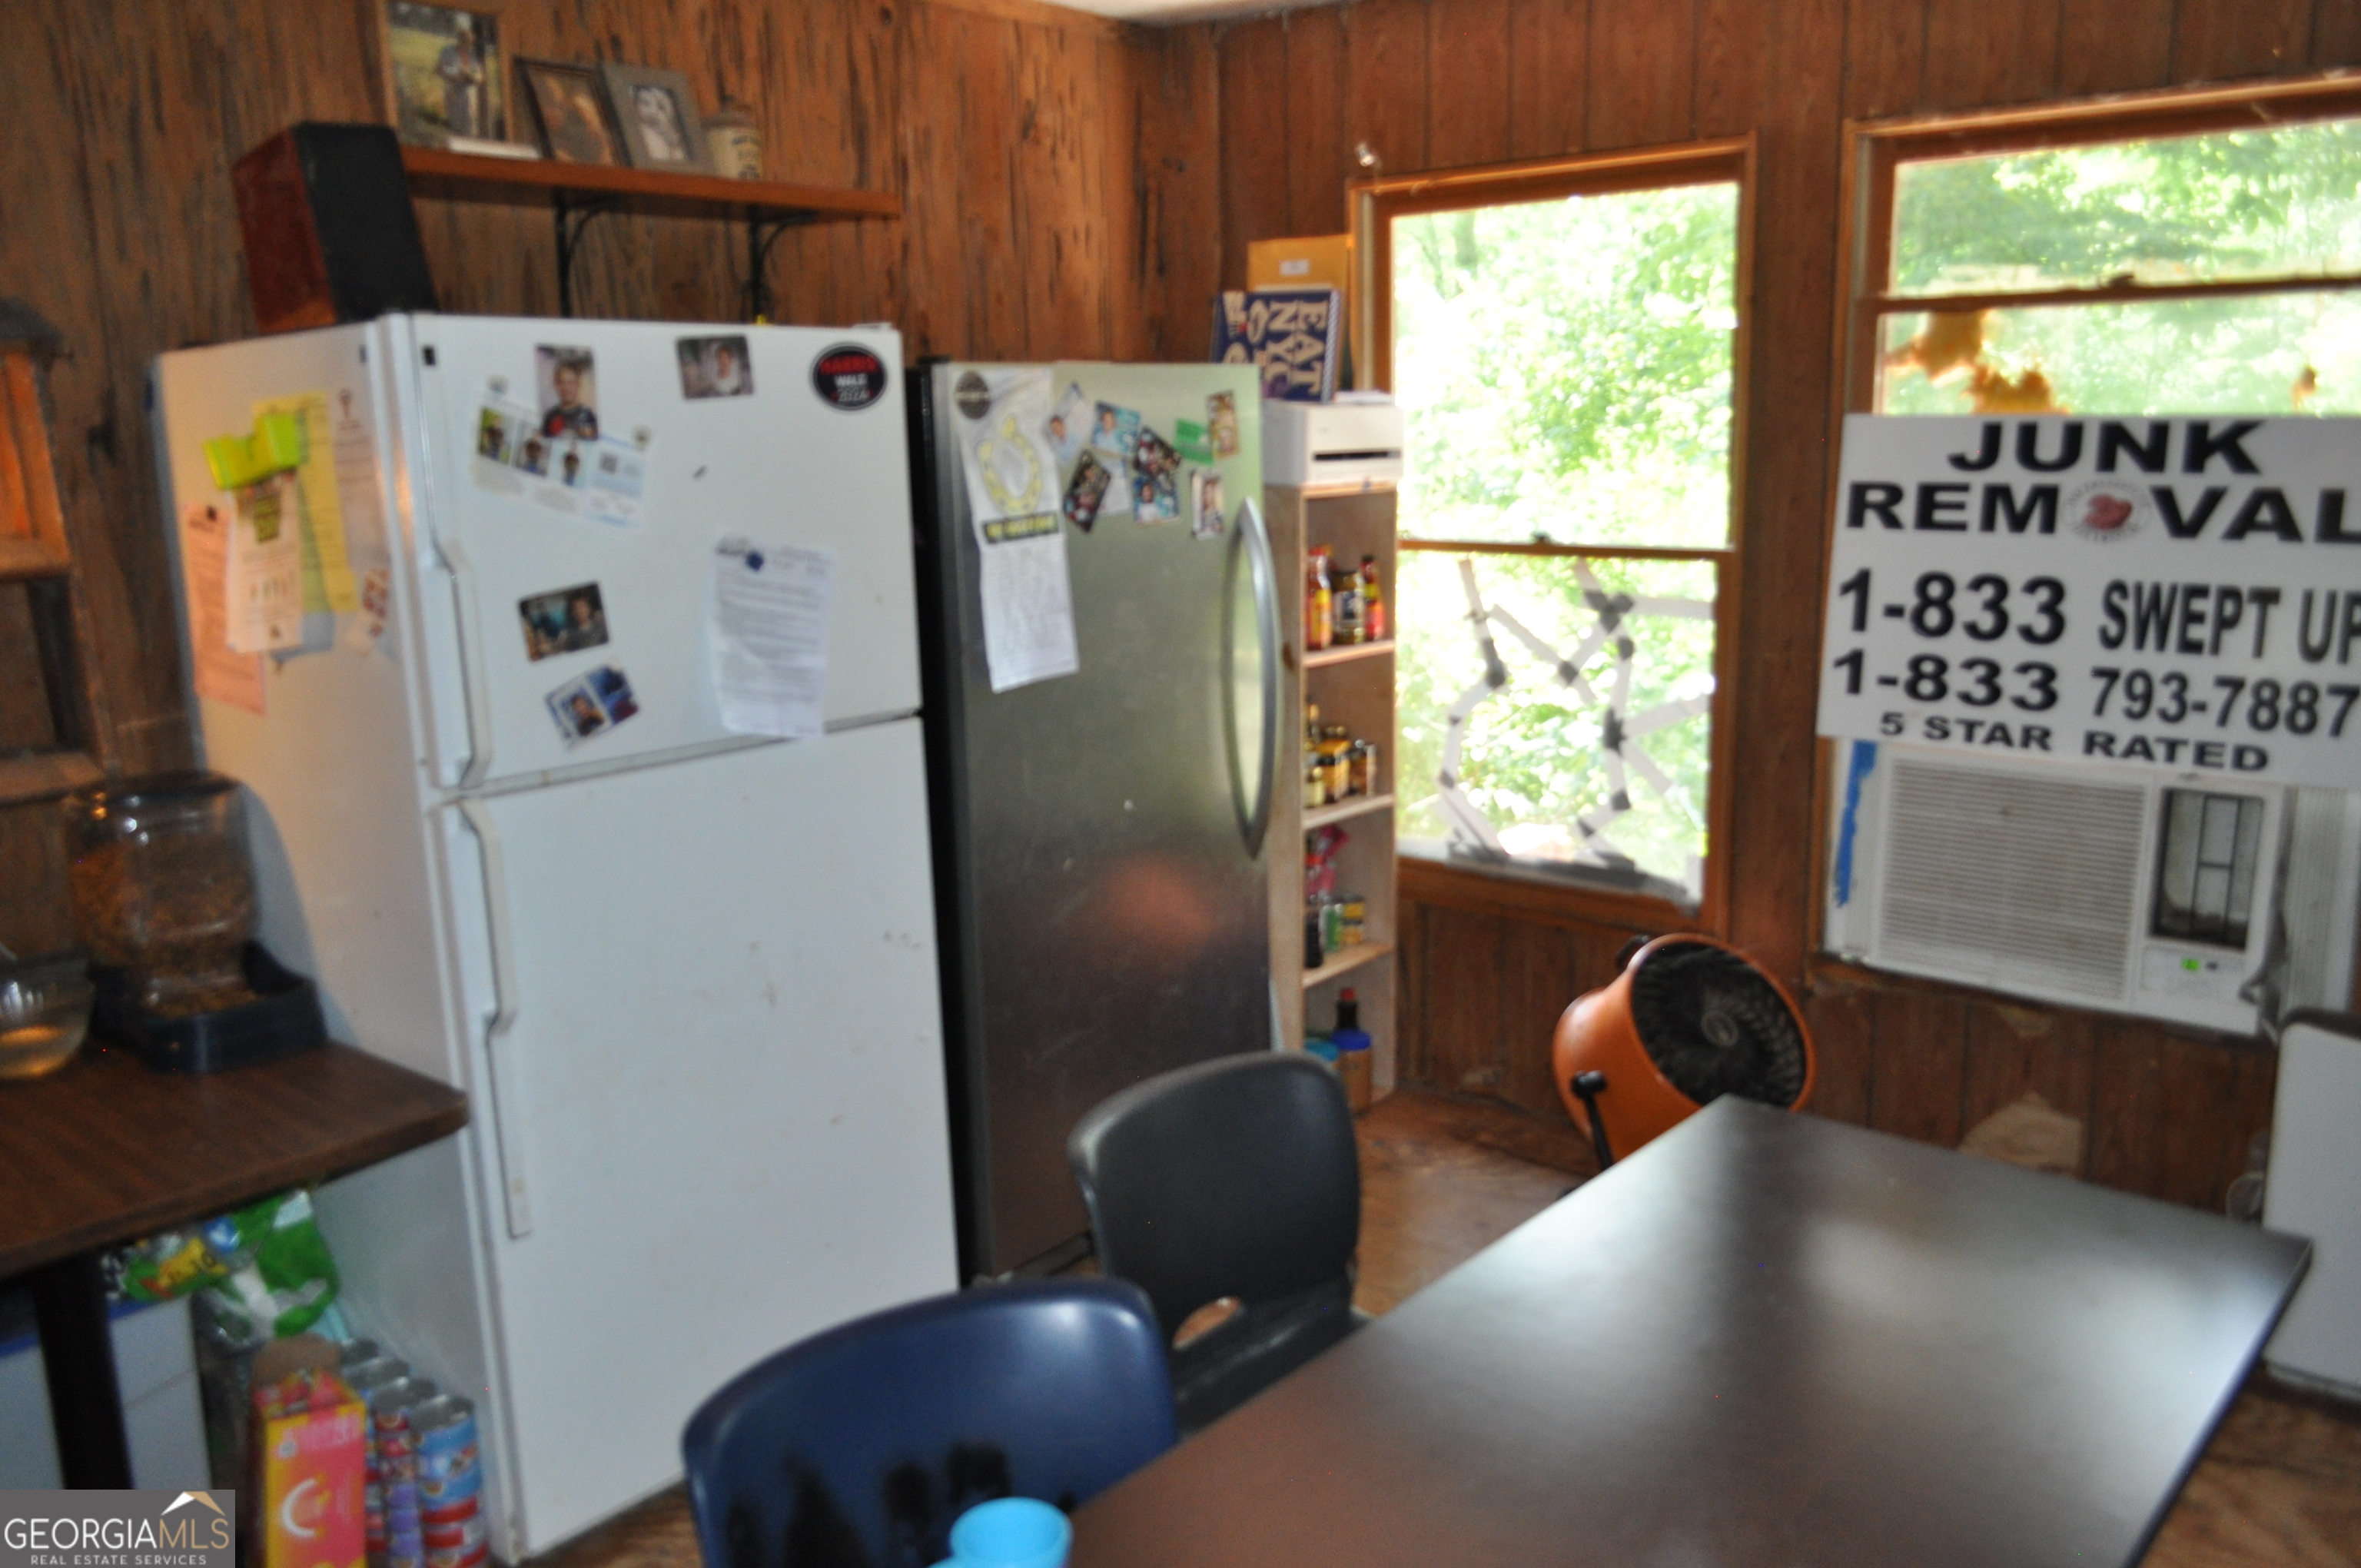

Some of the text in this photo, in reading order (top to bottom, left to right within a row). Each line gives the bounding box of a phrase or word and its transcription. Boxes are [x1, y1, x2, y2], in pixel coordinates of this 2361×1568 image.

[1947, 420, 2265, 475] JUNK
[1839, 568, 2361, 665] 1-833 SWEPT UP
[1833, 649, 2361, 738] 1-833 793-7887
[1881, 713, 2268, 771] 5 STAR RATED
